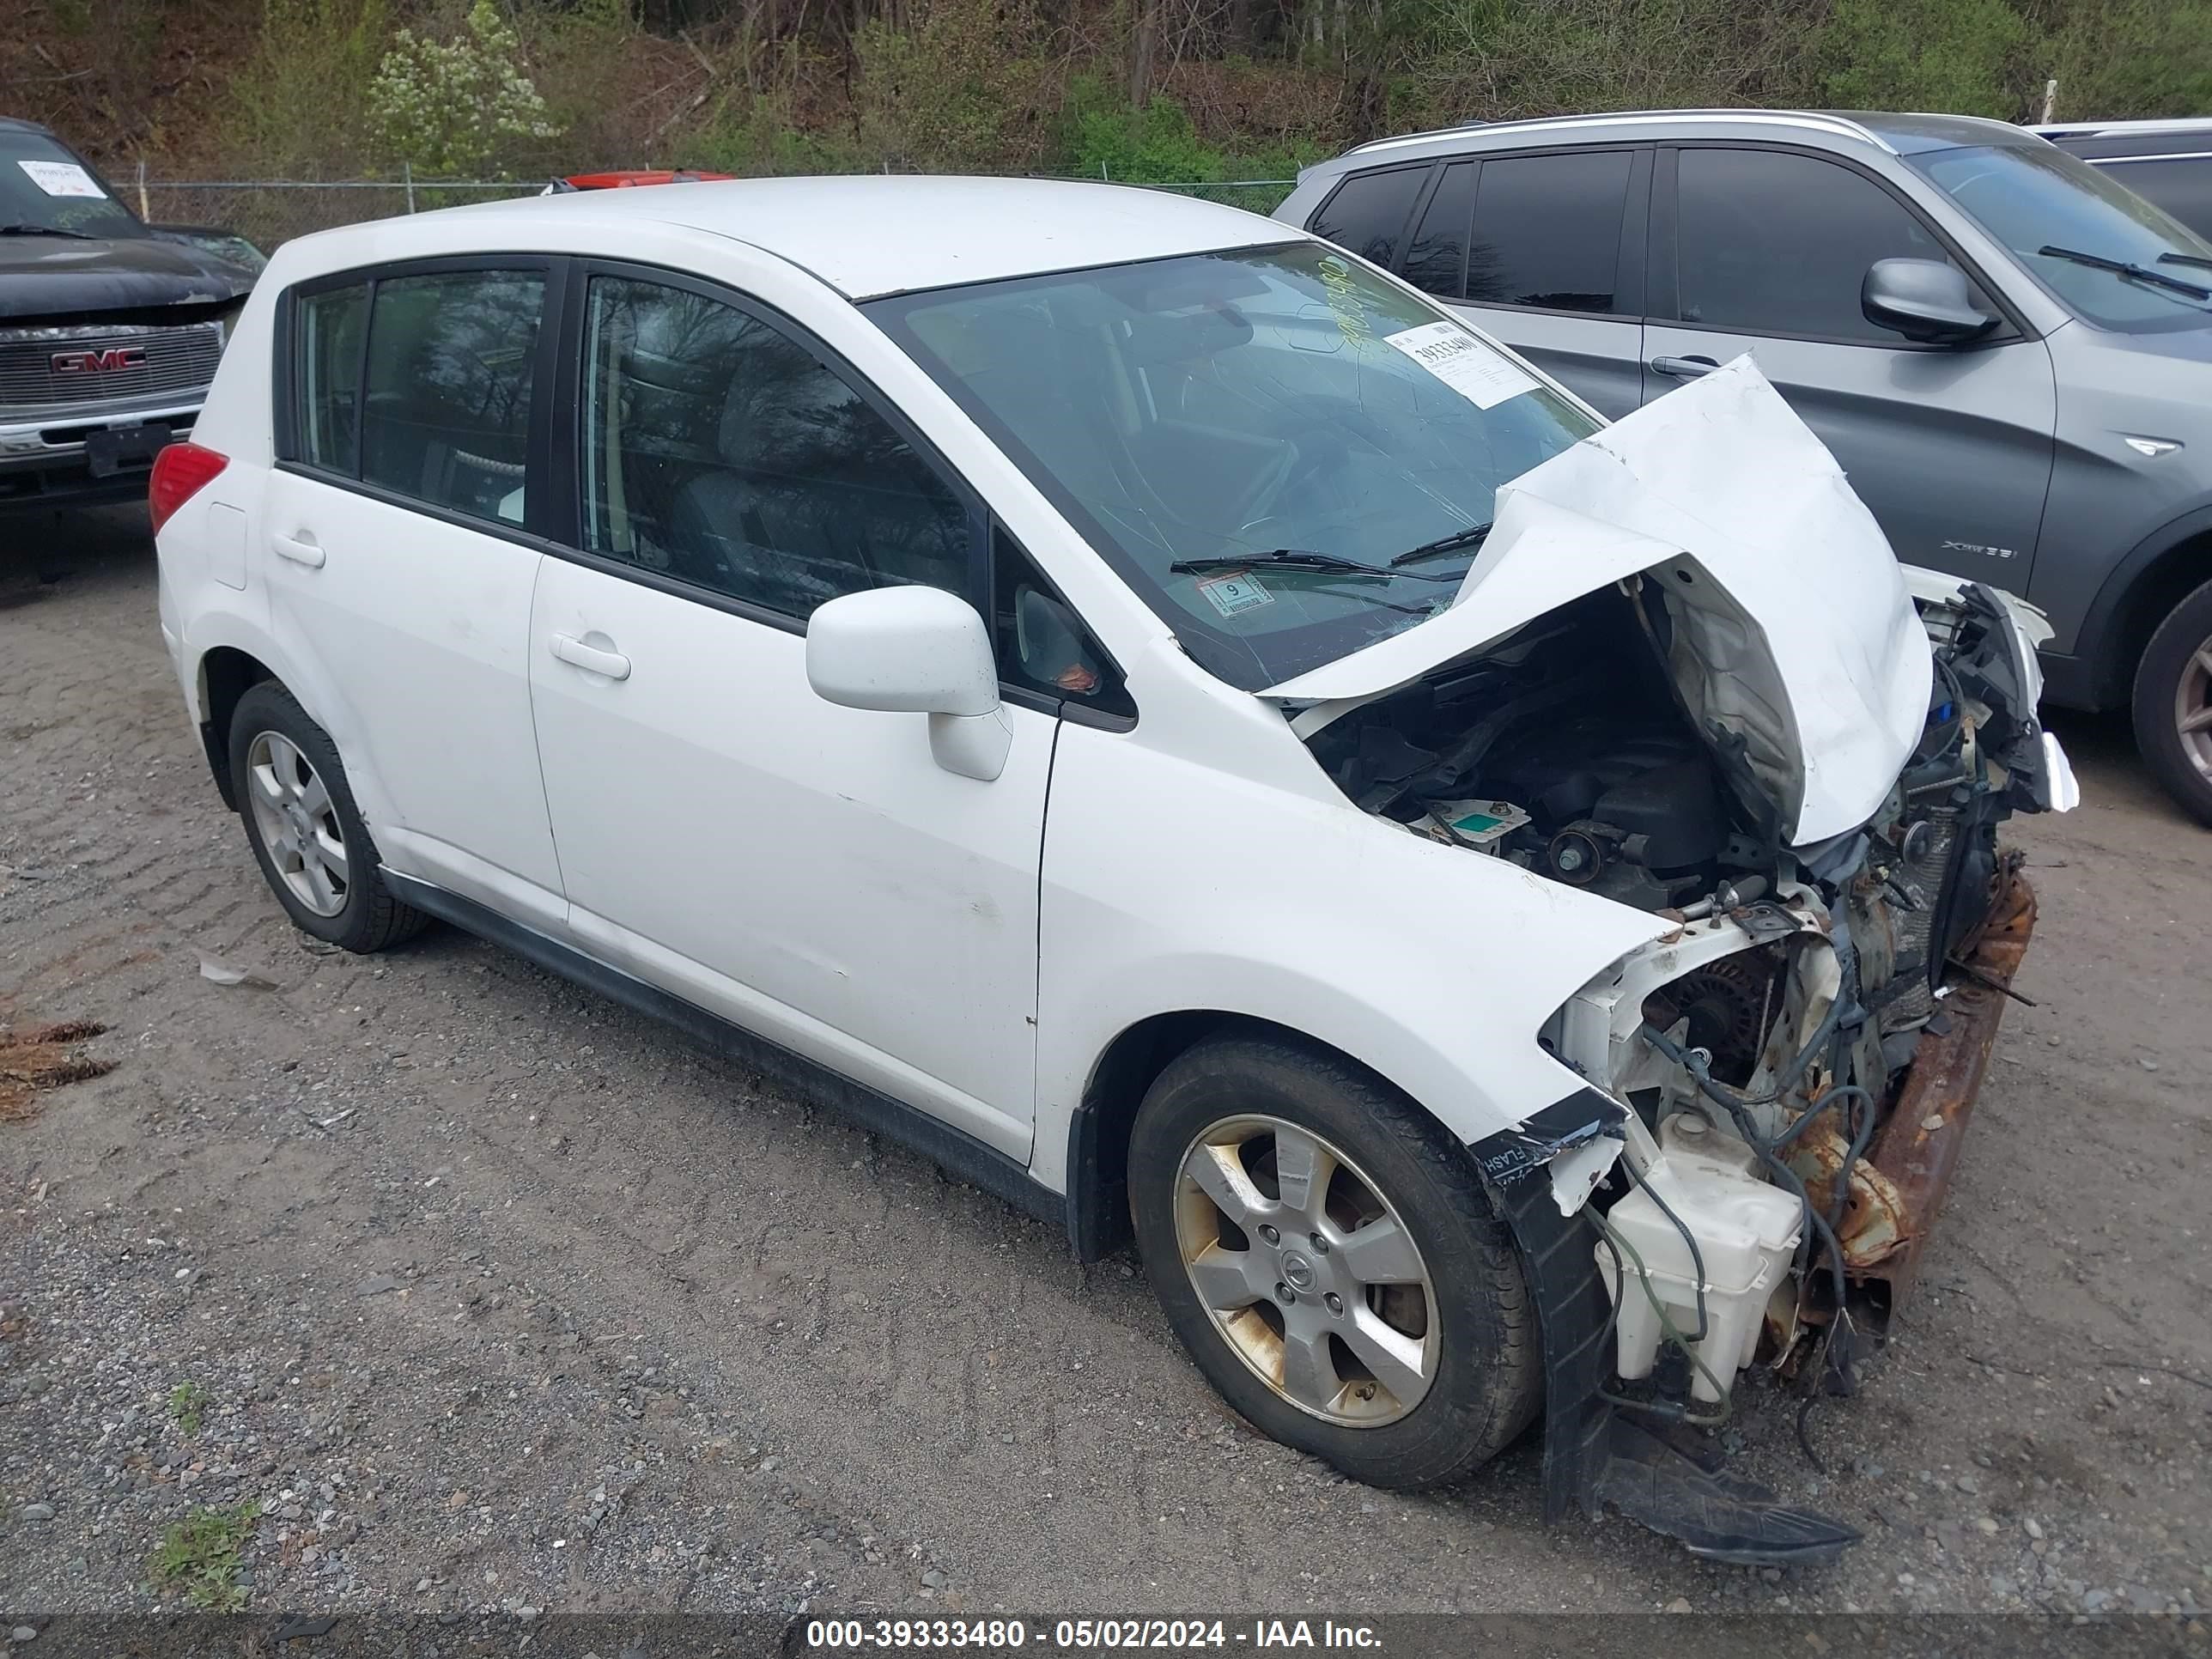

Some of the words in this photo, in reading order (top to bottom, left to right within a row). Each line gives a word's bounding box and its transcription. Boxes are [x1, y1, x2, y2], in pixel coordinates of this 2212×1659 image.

[52, 346, 148, 373] GMC
[1414, 336, 1478, 363] 39333480
[1226, 584, 1239, 596] 9
[1484, 1146, 1527, 1172] FLASH
